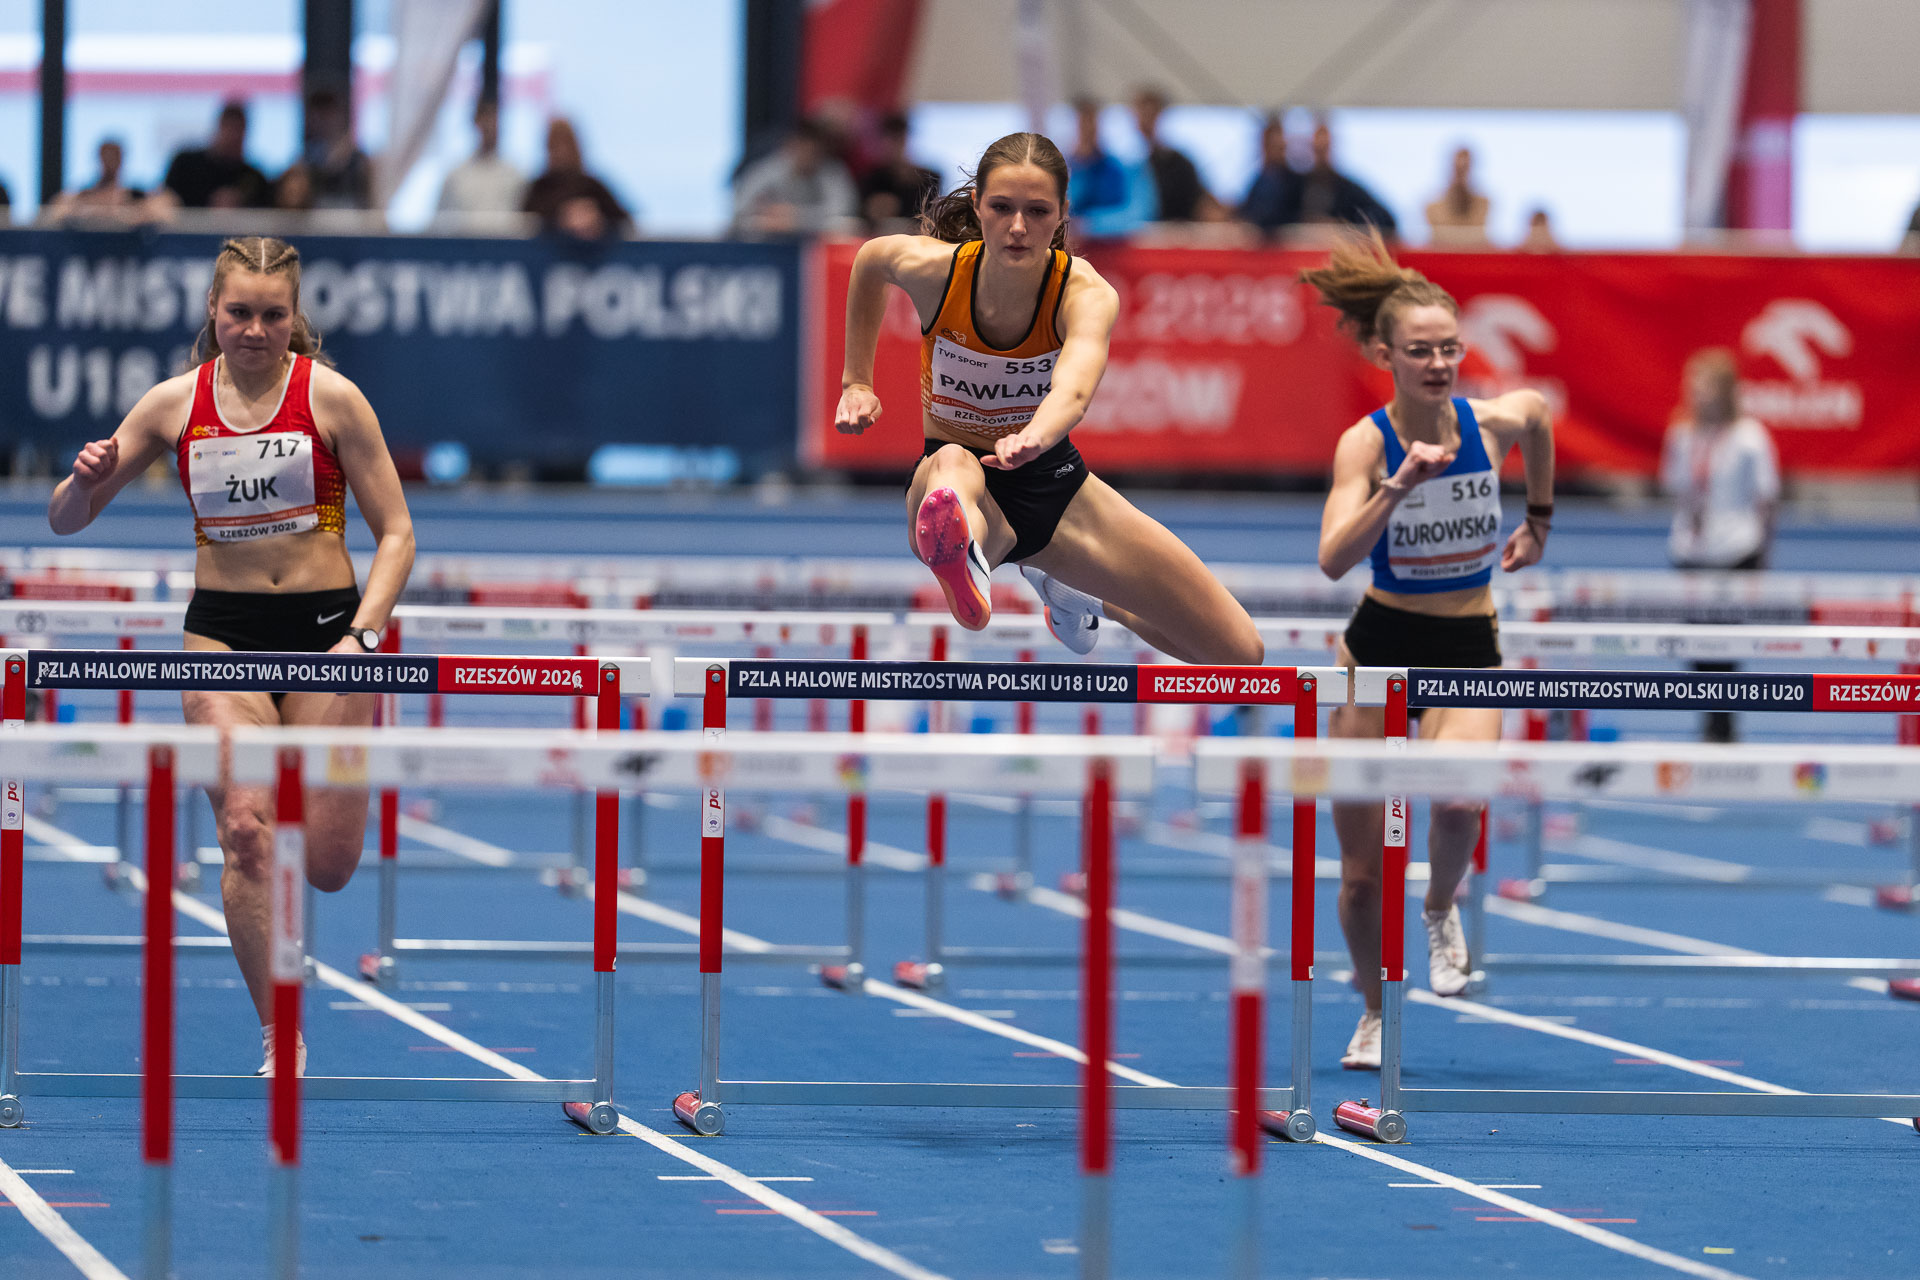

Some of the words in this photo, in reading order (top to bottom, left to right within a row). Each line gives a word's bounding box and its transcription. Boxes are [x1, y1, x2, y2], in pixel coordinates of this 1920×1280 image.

[56, 256, 538, 338] MISTOSTWA
[939, 347, 956, 360] TVP
[958, 355, 988, 369] SPORT
[1005, 358, 1051, 375] 553
[940, 373, 1051, 400] PAWLAK
[955, 410, 1008, 425] RZESZÓW
[1011, 413, 1035, 422] 202
[192, 425, 219, 437] esa
[257, 438, 301, 460] 717
[225, 474, 279, 503] ŻUK
[1452, 478, 1492, 502] 516
[219, 526, 269, 538] RZESZÓW
[271, 521, 298, 534] 2026
[1394, 514, 1498, 547] ŻUROWSKA
[38, 661, 80, 679] PZLA
[84, 662, 156, 679] HALOWE
[160, 663, 284, 681] MISTRZOSTWA
[287, 664, 346, 682] POLSKI
[351, 665, 382, 683] U18
[387, 666, 392, 682] i
[396, 667, 429, 684] U20
[455, 665, 538, 685] RZESZÓW
[541, 669, 582, 687] 2026
[738, 670, 781, 688] PZLA
[785, 671, 857, 689] HALOWE
[861, 671, 983, 690] MISTRZOSTWA
[987, 673, 1046, 692] POLSKI
[1051, 674, 1083, 692] U18
[1086, 675, 1092, 692] i
[1095, 675, 1129, 693] U20
[1154, 674, 1236, 694] RZESZÓW
[1240, 677, 1281, 695] 2026
[1417, 679, 1460, 697] PZLA
[1463, 680, 1535, 698] HALOWE
[1539, 681, 1660, 699] MISTRZOSTWA
[1664, 682, 1723, 700] POLSKI
[1727, 683, 1760, 700] U18
[1763, 683, 1768, 701] i
[1772, 684, 1804, 702] U20
[1829, 682, 1910, 702] RZESZÓW
